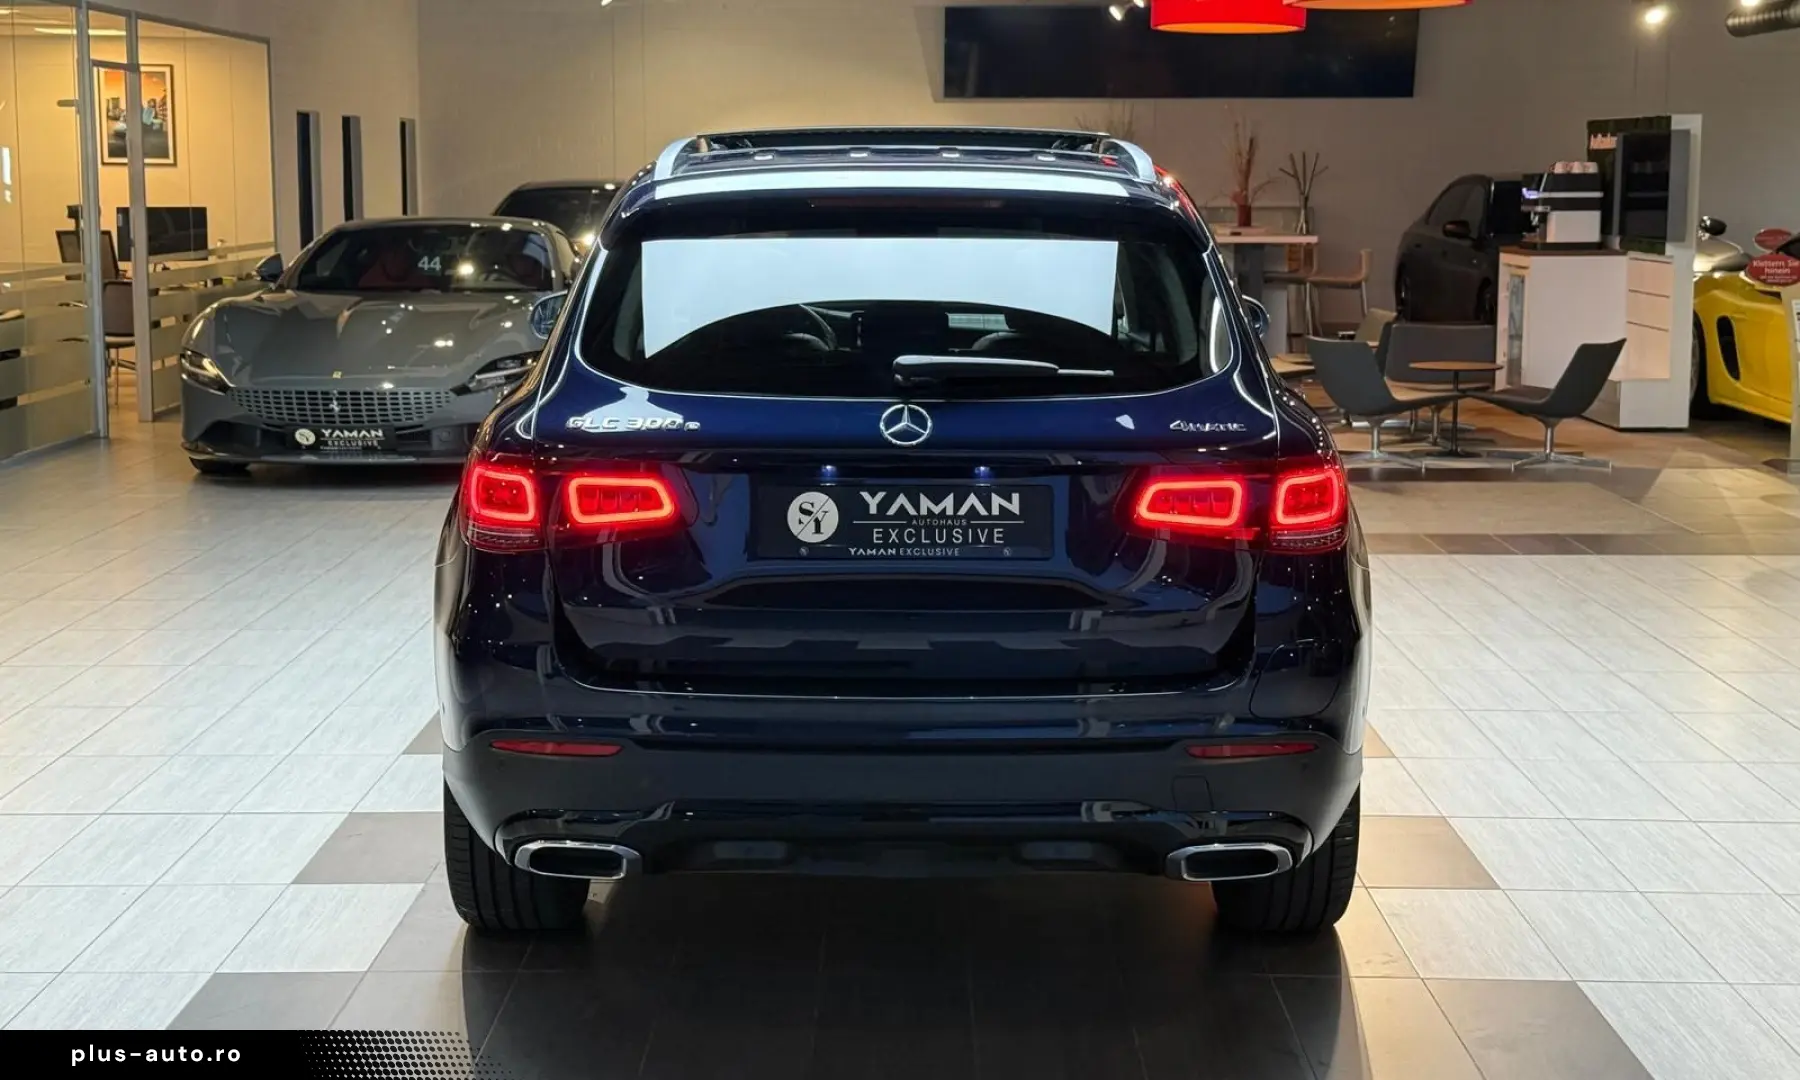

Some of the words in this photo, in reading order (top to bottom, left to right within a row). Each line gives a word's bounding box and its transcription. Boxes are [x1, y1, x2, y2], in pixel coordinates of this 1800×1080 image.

[417, 255, 442, 271] 44
[565, 416, 620, 430] GLC
[627, 416, 684, 431] 300
[321, 428, 383, 438] YAMAN
[859, 491, 1020, 516] YAMAN
[873, 528, 1005, 543] EXCLUSIVE
[848, 547, 896, 556] YAMAN
[899, 547, 960, 556] EXCLUSIVE
